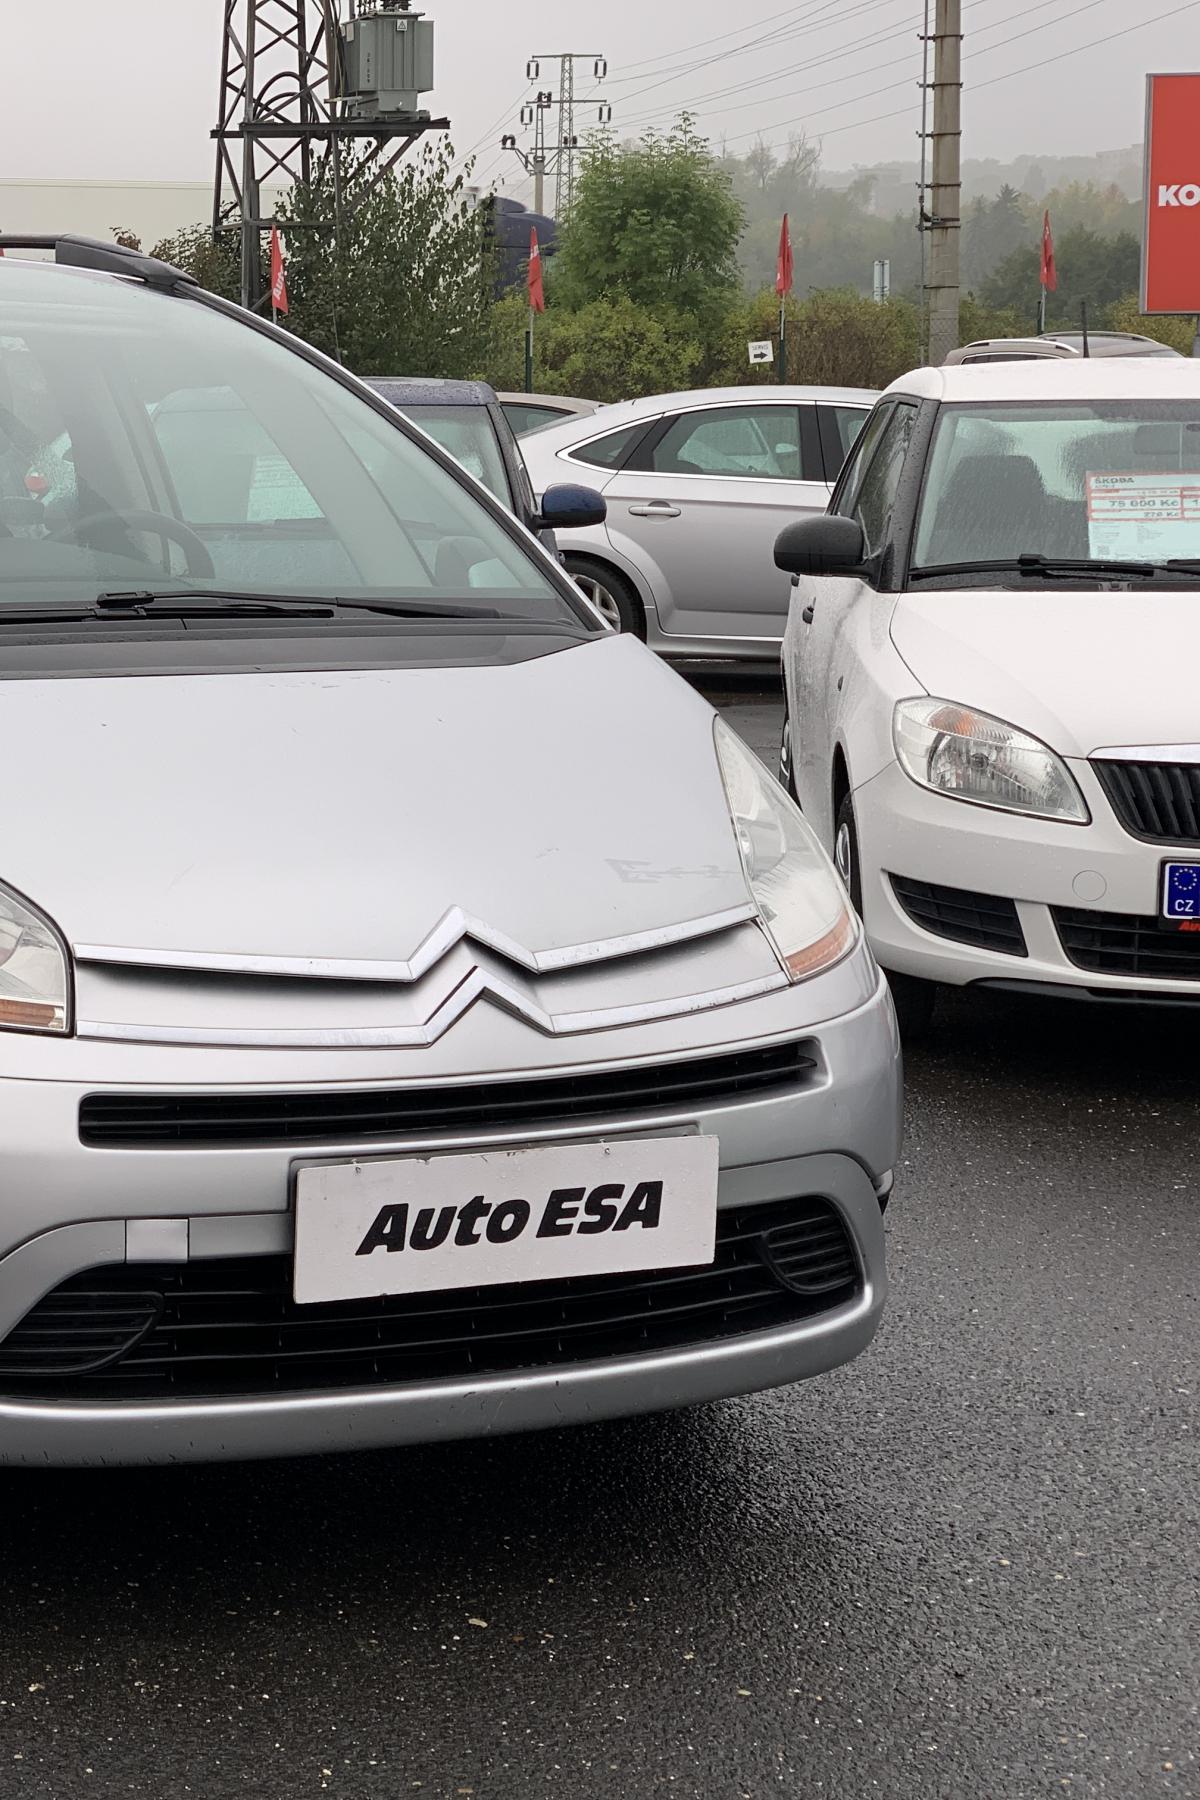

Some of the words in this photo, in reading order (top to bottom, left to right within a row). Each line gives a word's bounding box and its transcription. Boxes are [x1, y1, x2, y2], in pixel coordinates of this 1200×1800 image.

[1174, 899, 1194, 912] CZ
[355, 1195, 531, 1256] Auto
[535, 1180, 664, 1239] ESA
